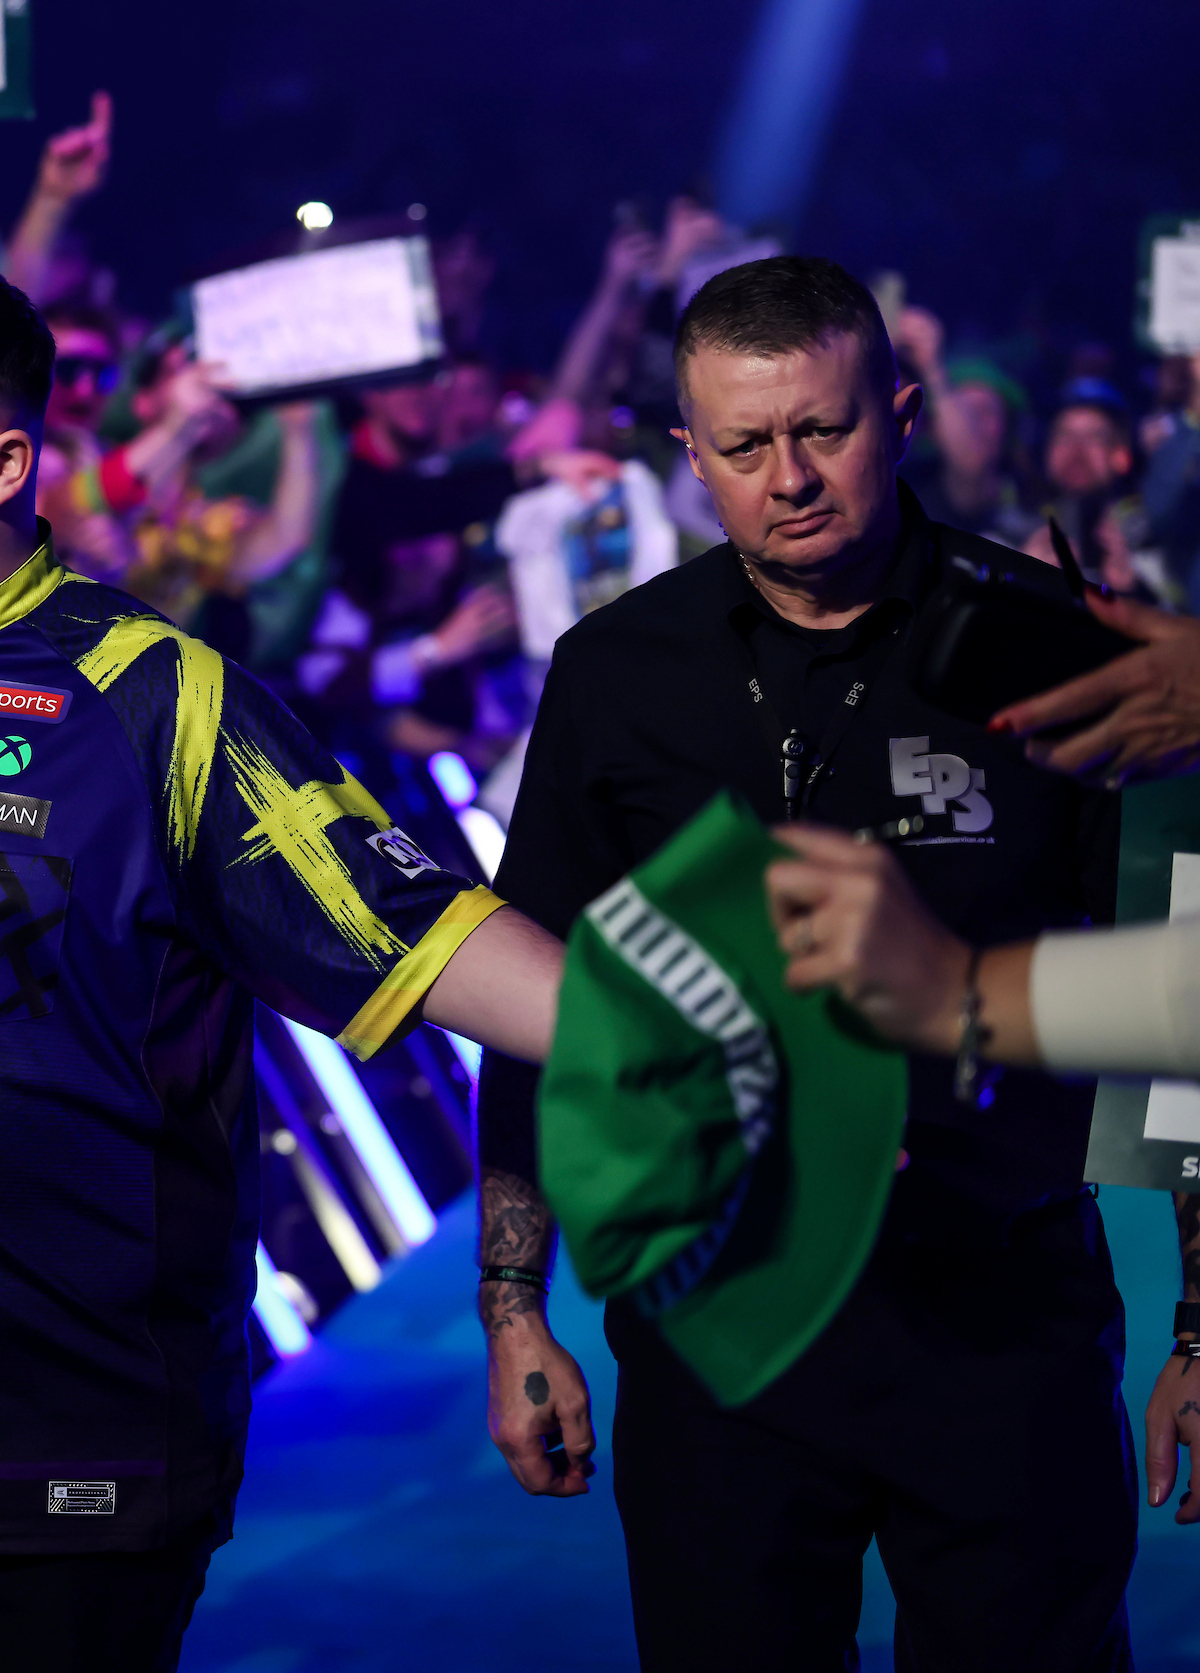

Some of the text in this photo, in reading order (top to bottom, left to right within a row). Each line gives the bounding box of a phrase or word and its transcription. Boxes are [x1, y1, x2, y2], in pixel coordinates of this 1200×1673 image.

[748, 678, 764, 703] EPS
[844, 681, 866, 706] EPS
[888, 735, 995, 834] EPS
